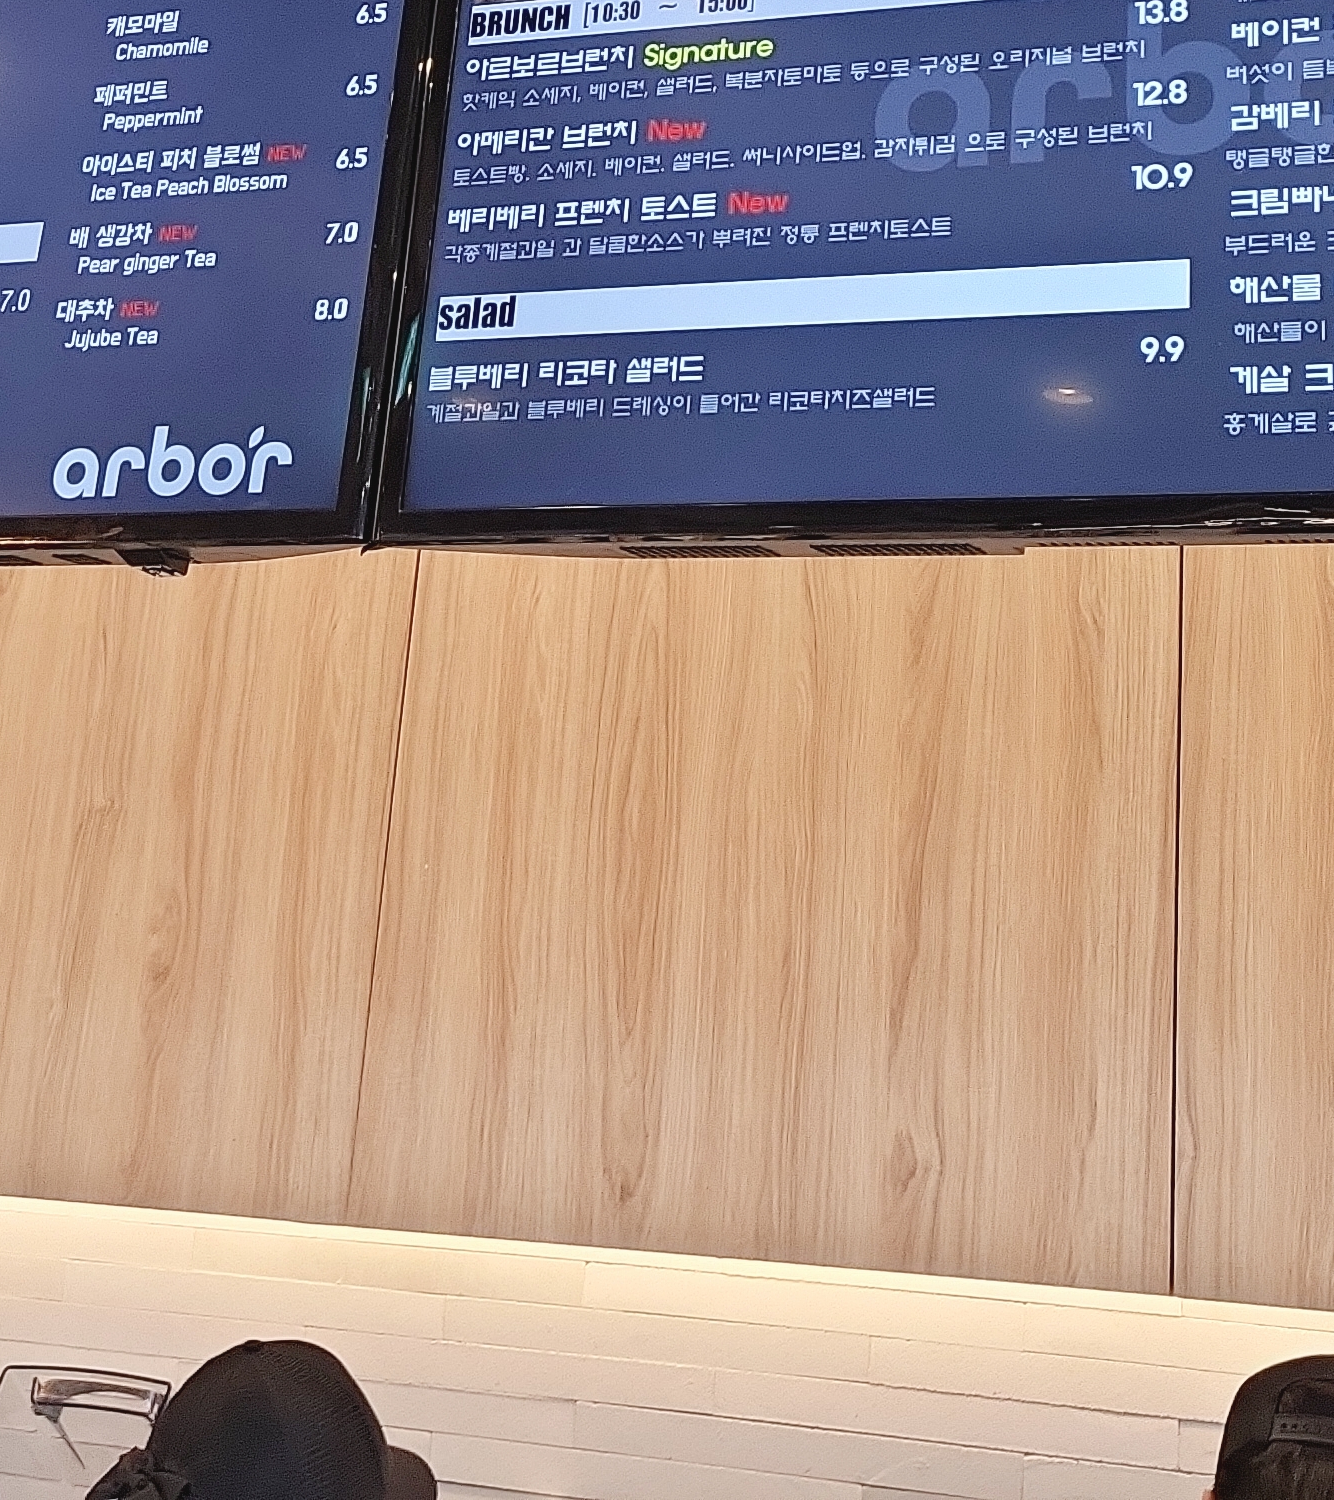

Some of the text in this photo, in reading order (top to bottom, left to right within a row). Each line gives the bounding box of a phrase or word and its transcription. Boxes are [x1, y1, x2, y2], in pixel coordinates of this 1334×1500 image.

[107, 11, 179, 36] 캐모마일
[471, 5, 570, 37] BRUNCH
[584, 0, 640, 28] [10:30
[1232, 17, 1319, 47] 베이컨
[116, 37, 208, 60] Chamomile
[467, 39, 773, 80] 아르보르브런치 Signature
[94, 81, 167, 106] 페퍼민트
[1133, 80, 1187, 106] 12.8
[103, 106, 203, 132] Peppermint
[1231, 101, 1320, 131] 감베리
[458, 120, 706, 155] 아메리칸 브런치 New
[83, 143, 305, 176] 아이스티 피치 블로썸 NEW
[336, 148, 367, 169] 6.5
[91, 175, 287, 201] Ice Tea Peach Blossom
[1132, 163, 1192, 189] 10.9
[448, 192, 789, 232] 베리베리 프렌치 토스트 New
[70, 227, 89, 248] 배
[97, 223, 152, 247] 생강차
[326, 222, 358, 243] 7.0
[78, 250, 216, 275] Pear ginger Tea
[1, 289, 30, 311] 7.0
[1230, 274, 1321, 303] 해산물
[56, 298, 158, 322] 대추차 NEW
[315, 299, 348, 320] 8.0
[439, 296, 516, 330] salad
[65, 327, 158, 351] Jujube Tea
[1141, 336, 1184, 362] 9.9
[429, 356, 703, 391] 블루베리 리코타 샐러드
[1230, 366, 1291, 393] 게살
[52, 425, 293, 499] arbor
